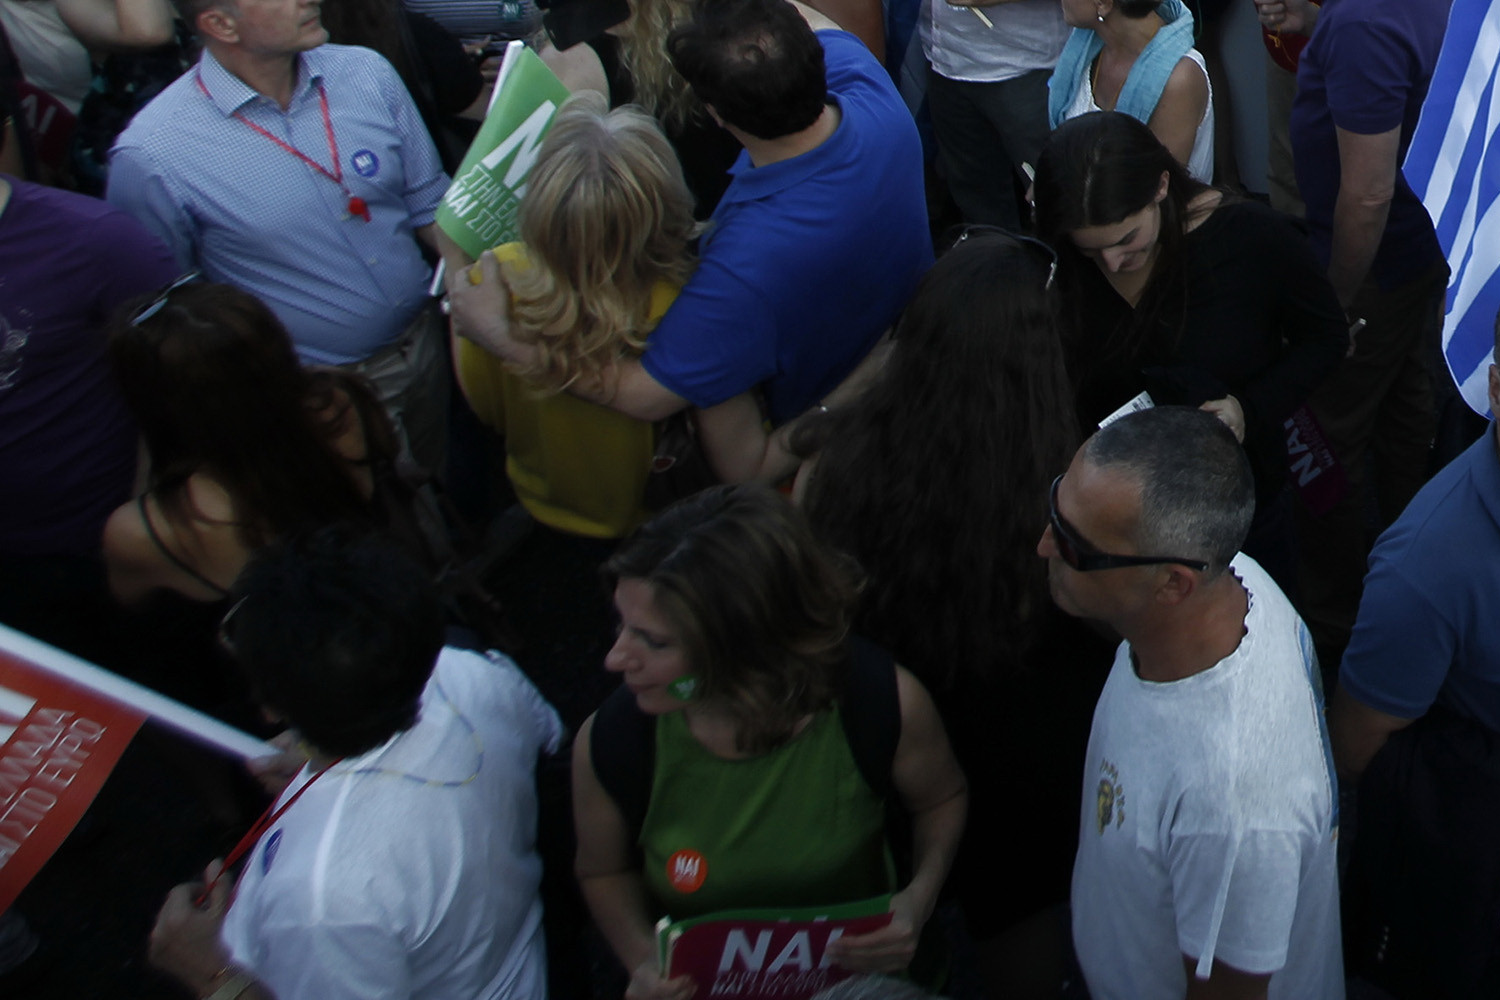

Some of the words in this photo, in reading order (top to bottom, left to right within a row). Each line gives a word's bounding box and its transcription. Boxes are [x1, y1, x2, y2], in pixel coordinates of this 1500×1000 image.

[443, 180, 479, 218] ΝΑΙ
[466, 208, 503, 243] ΣΤΟ
[36, 716, 107, 788] ΕΥΡΩ
[675, 855, 700, 877] ΝΑΙ
[717, 927, 845, 973] ΝΑΙ
